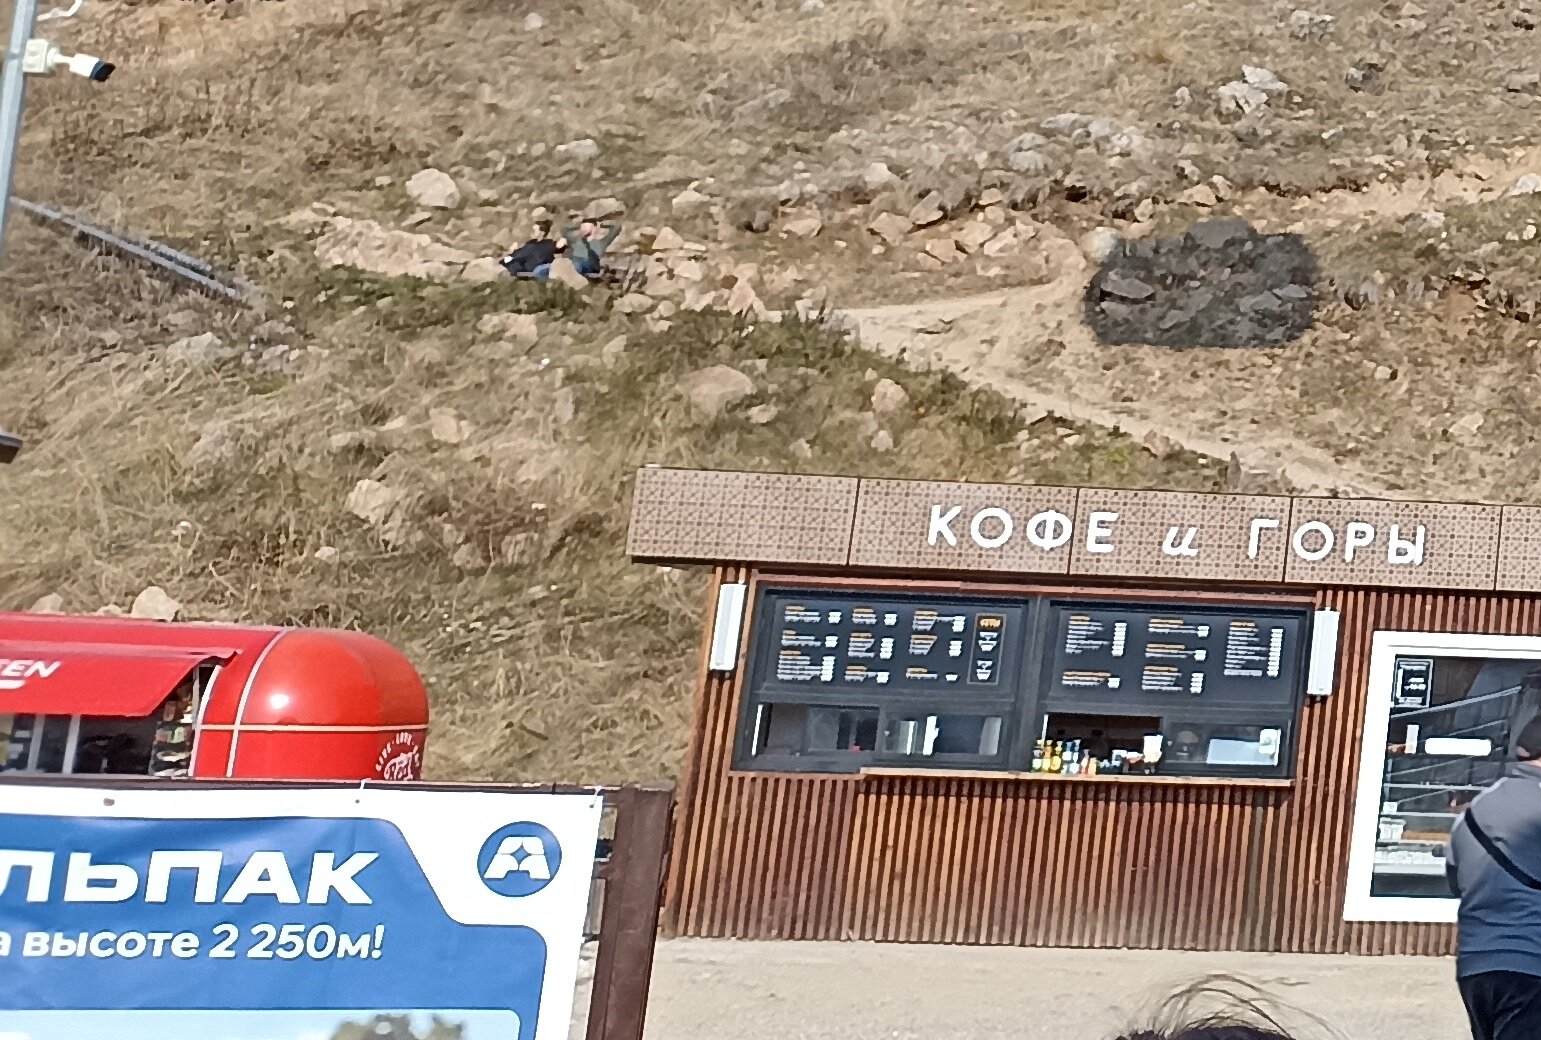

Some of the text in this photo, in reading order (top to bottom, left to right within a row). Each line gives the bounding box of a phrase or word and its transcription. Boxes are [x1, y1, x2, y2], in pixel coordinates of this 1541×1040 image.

[926, 503, 1426, 567] КОФЕ и ГОРЫ
[0, 658, 62, 678] EN
[0, 849, 380, 905] ЛЬПАК
[22, 929, 200, 959] высоте
[208, 922, 240, 959] 2
[246, 922, 386, 960] 250м!
